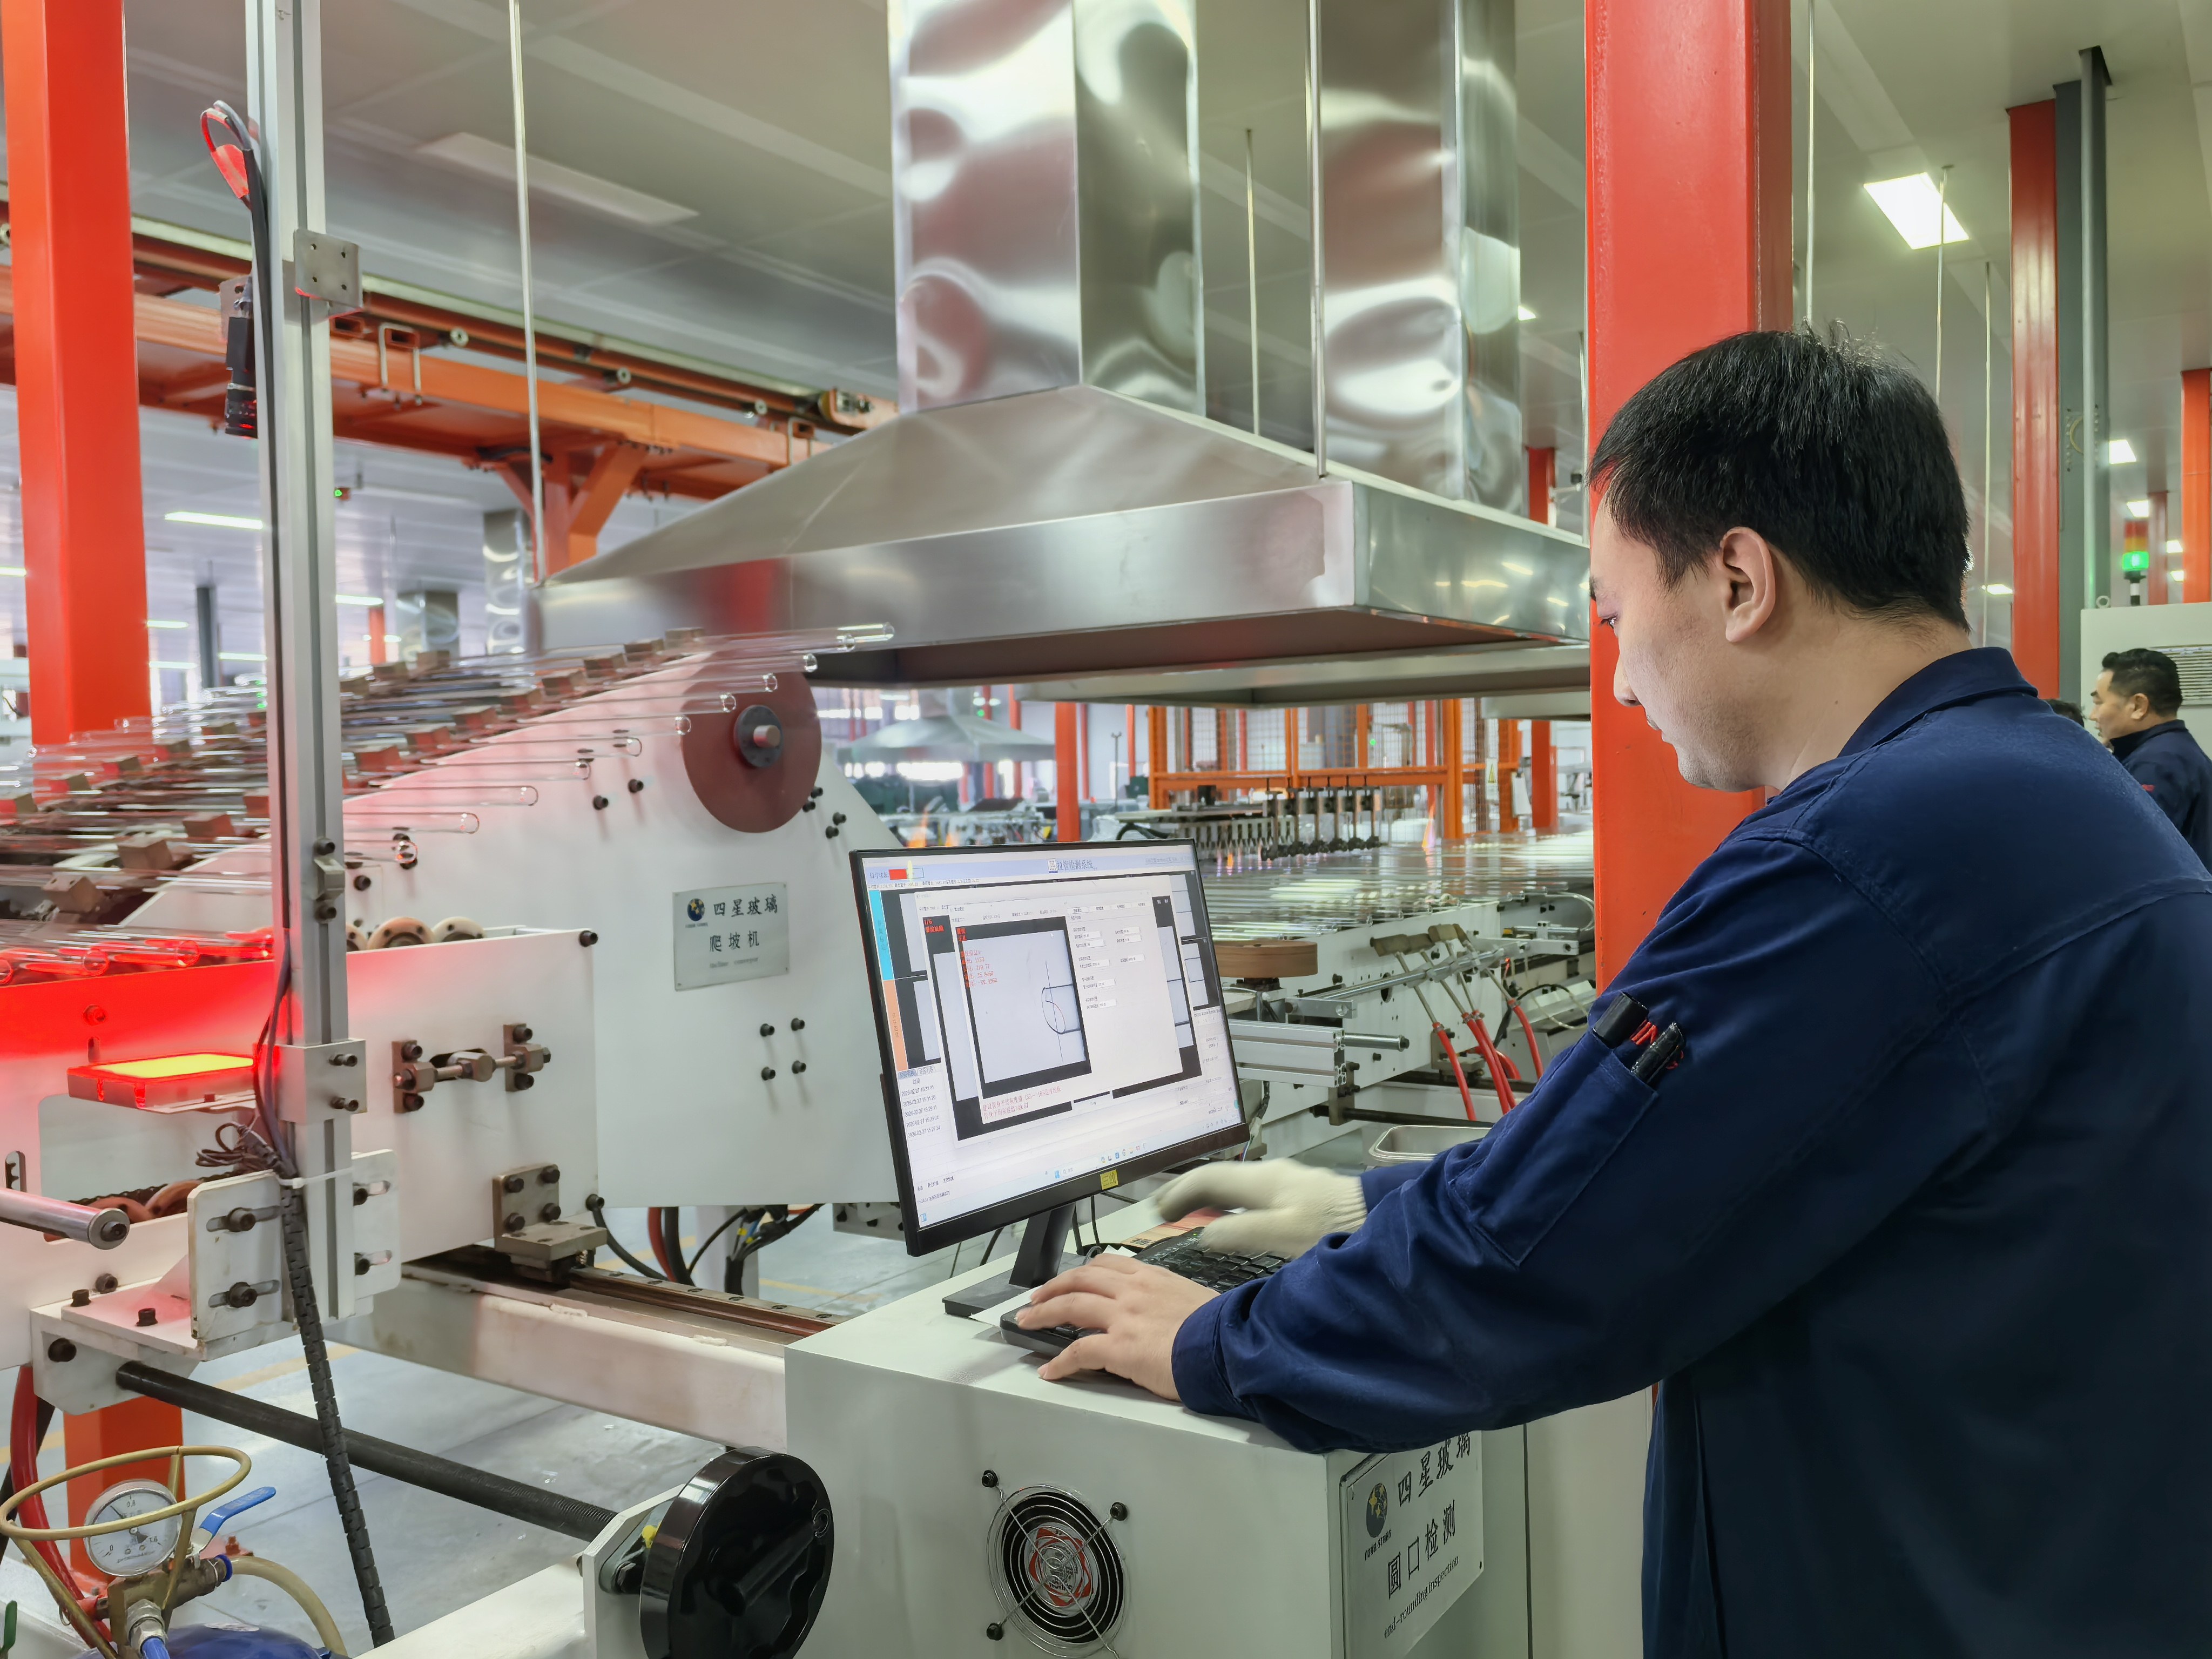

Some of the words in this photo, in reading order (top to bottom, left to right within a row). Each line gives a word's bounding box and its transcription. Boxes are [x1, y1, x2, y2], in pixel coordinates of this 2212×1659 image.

[713, 894, 778, 917] 四星玻璃
[710, 930, 759, 952] 爬坡机
[1384, 1587, 1428, 1638] end-rounding
[1428, 1556, 1459, 1594] inspection
